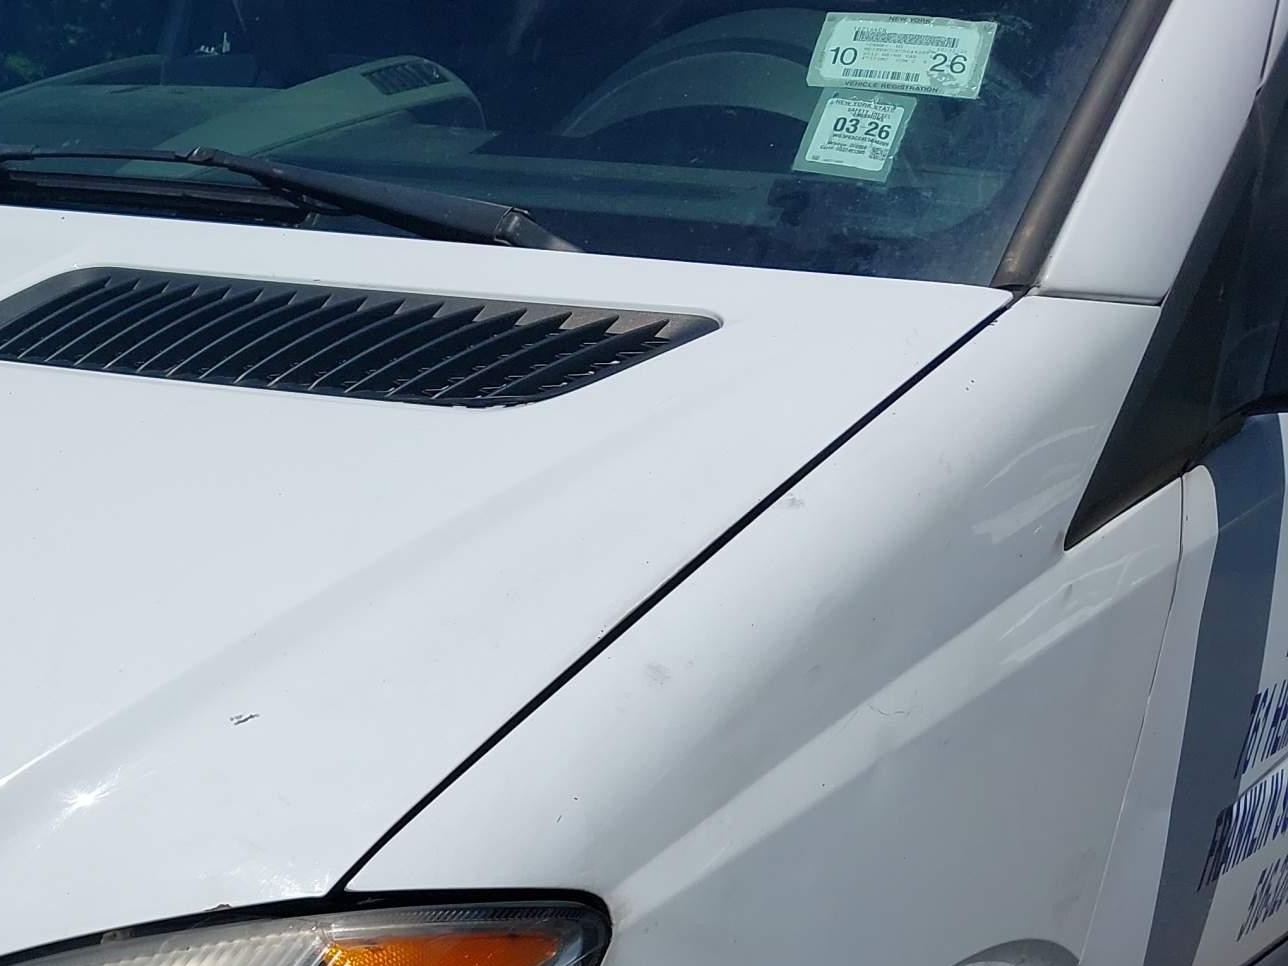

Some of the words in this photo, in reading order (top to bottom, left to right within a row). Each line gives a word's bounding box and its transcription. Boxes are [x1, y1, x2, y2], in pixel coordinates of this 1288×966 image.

[830, 46, 858, 65] 10
[929, 53, 968, 74] 26
[844, 80, 879, 89] VEHICLE
[880, 83, 939, 93] REGISTRATION
[833, 116, 860, 134] 03
[864, 121, 892, 140] 26
[1196, 768, 1284, 892] FRANKLIN
